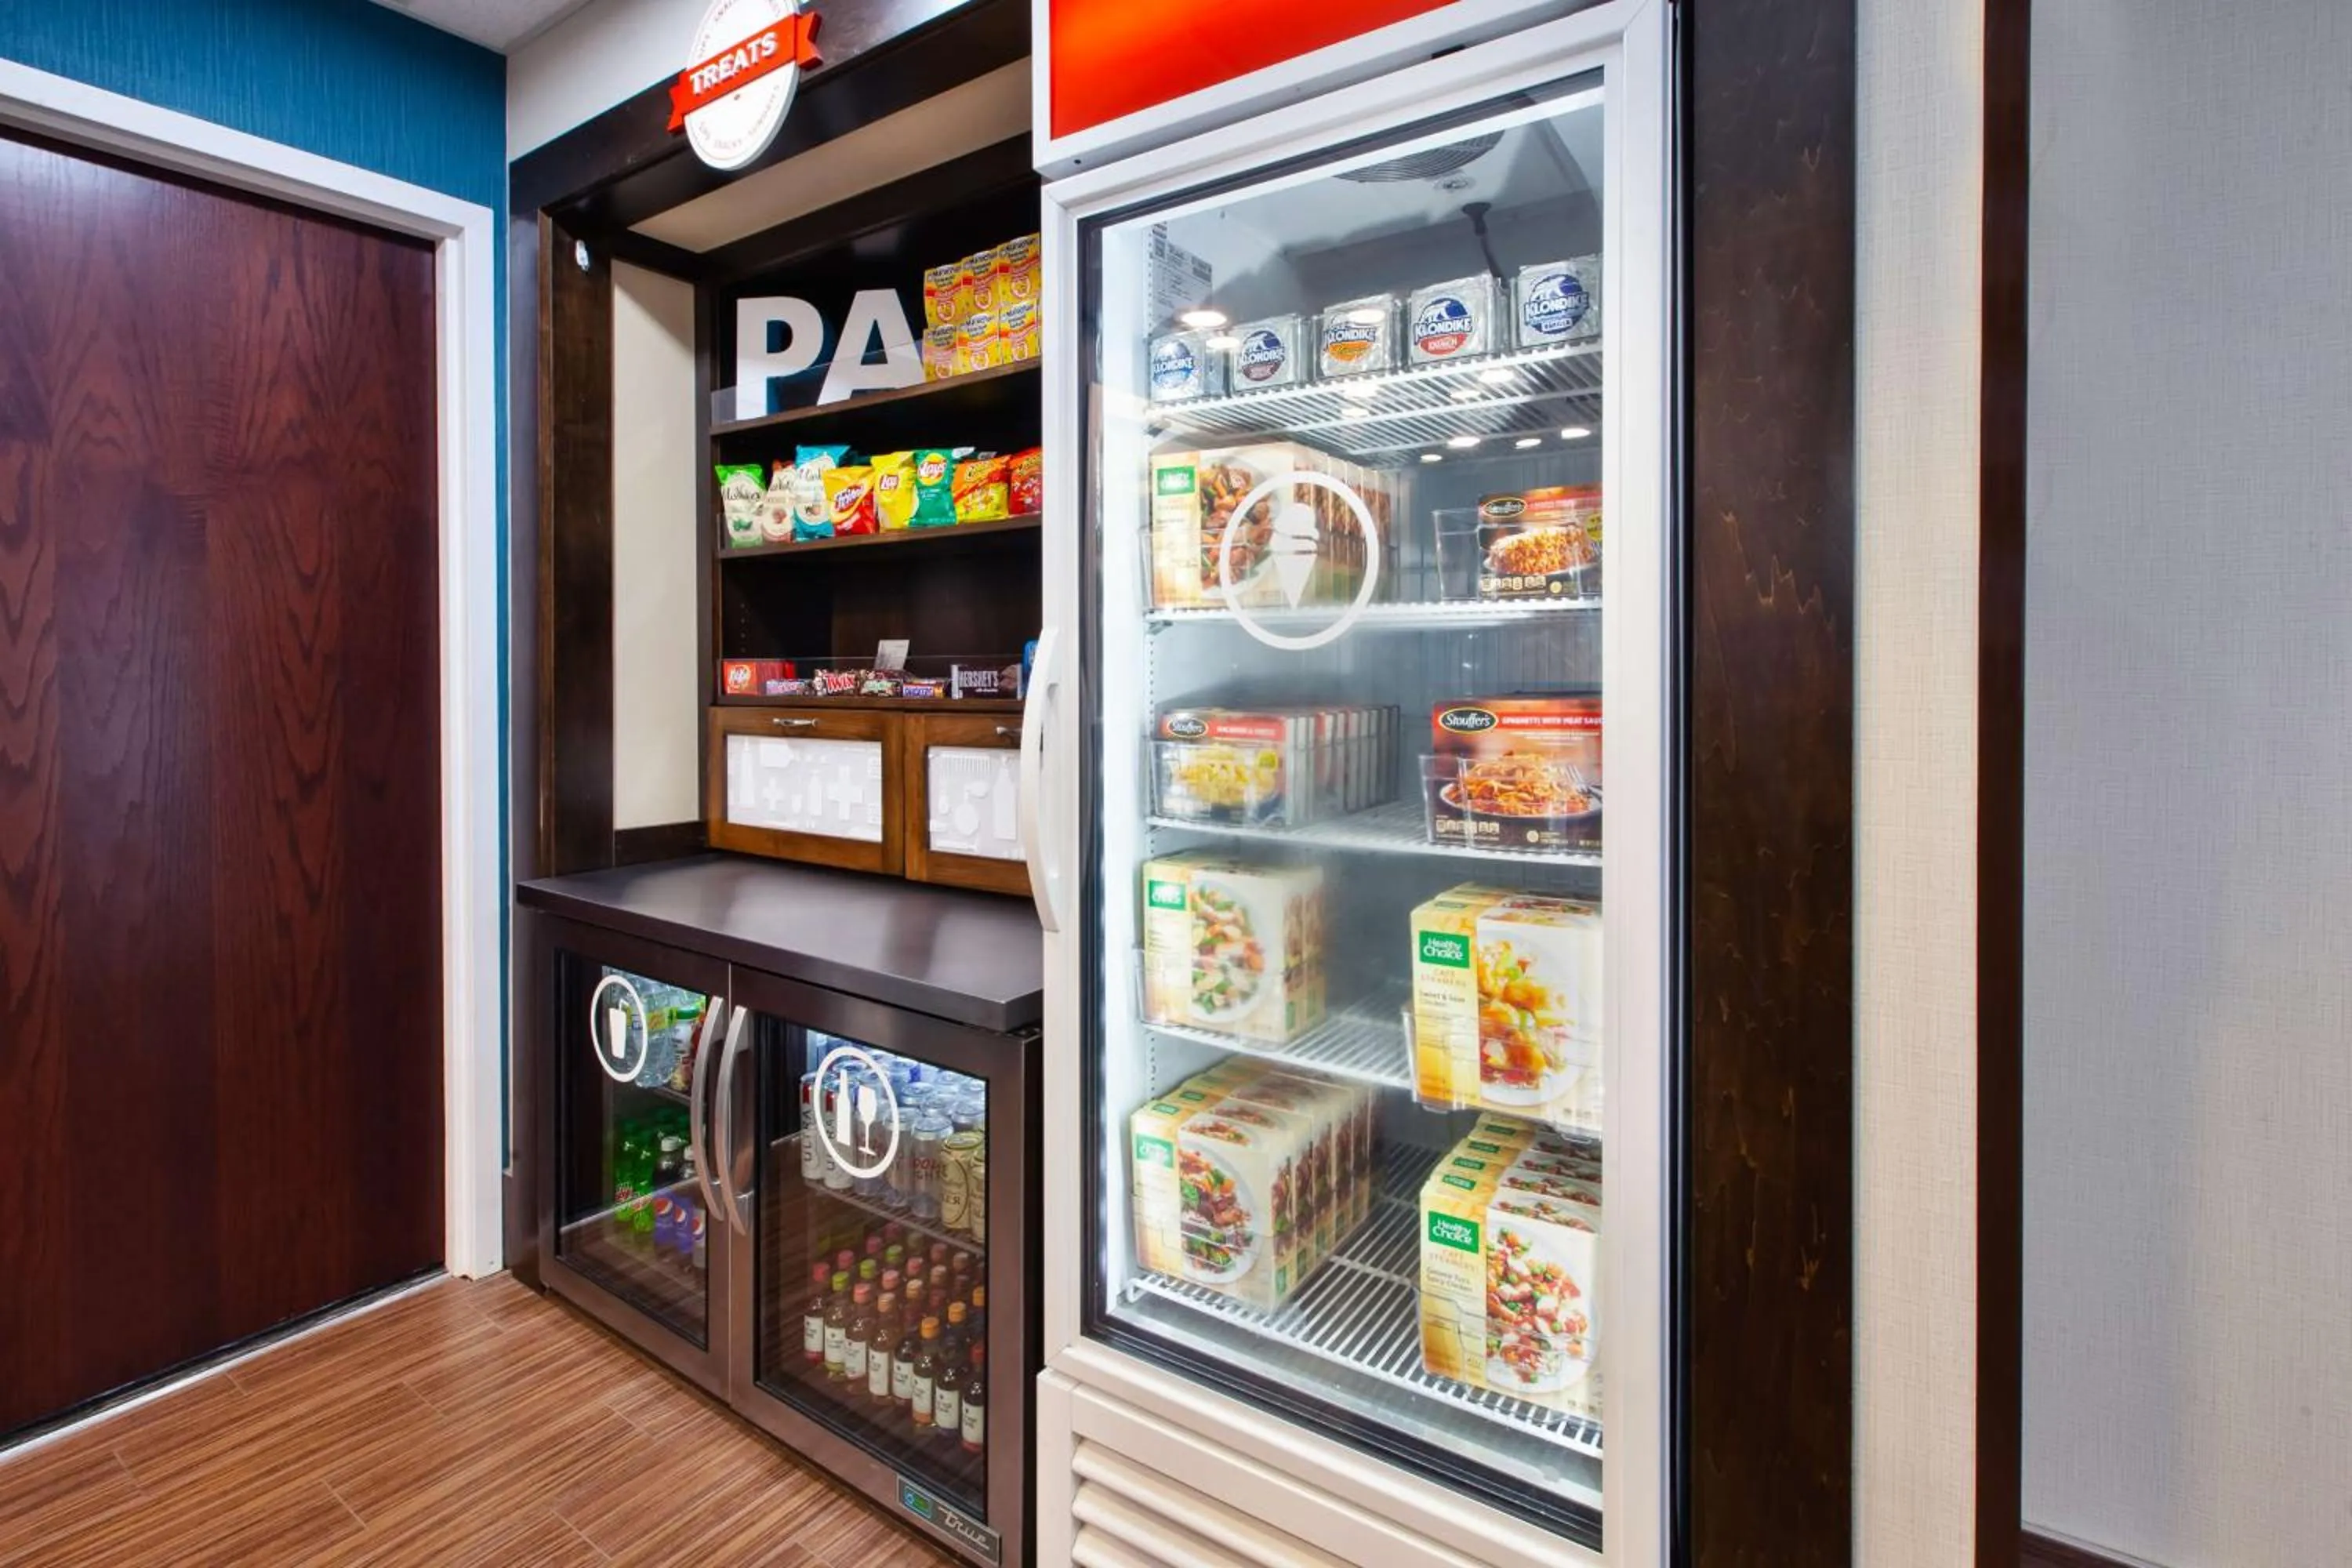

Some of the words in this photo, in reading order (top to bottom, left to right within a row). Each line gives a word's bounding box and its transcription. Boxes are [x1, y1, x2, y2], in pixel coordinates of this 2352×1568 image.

[690, 31, 778, 95] TREATS
[1524, 292, 1589, 322] KLONDIKE
[1325, 326, 1376, 346] KLONDIKE
[1414, 315, 1473, 341] KLONDIKE
[736, 288, 927, 421] PA
[959, 670, 998, 688] HERSHEY'S
[1446, 713, 1491, 728] Stouffer's
[1502, 717, 1541, 725] SPAGHETTI
[1423, 945, 1464, 960] Choice
[1428, 937, 1462, 951] Healthy
[1432, 1225, 1473, 1246] Choice
[1436, 1217, 1472, 1236] Healthy
